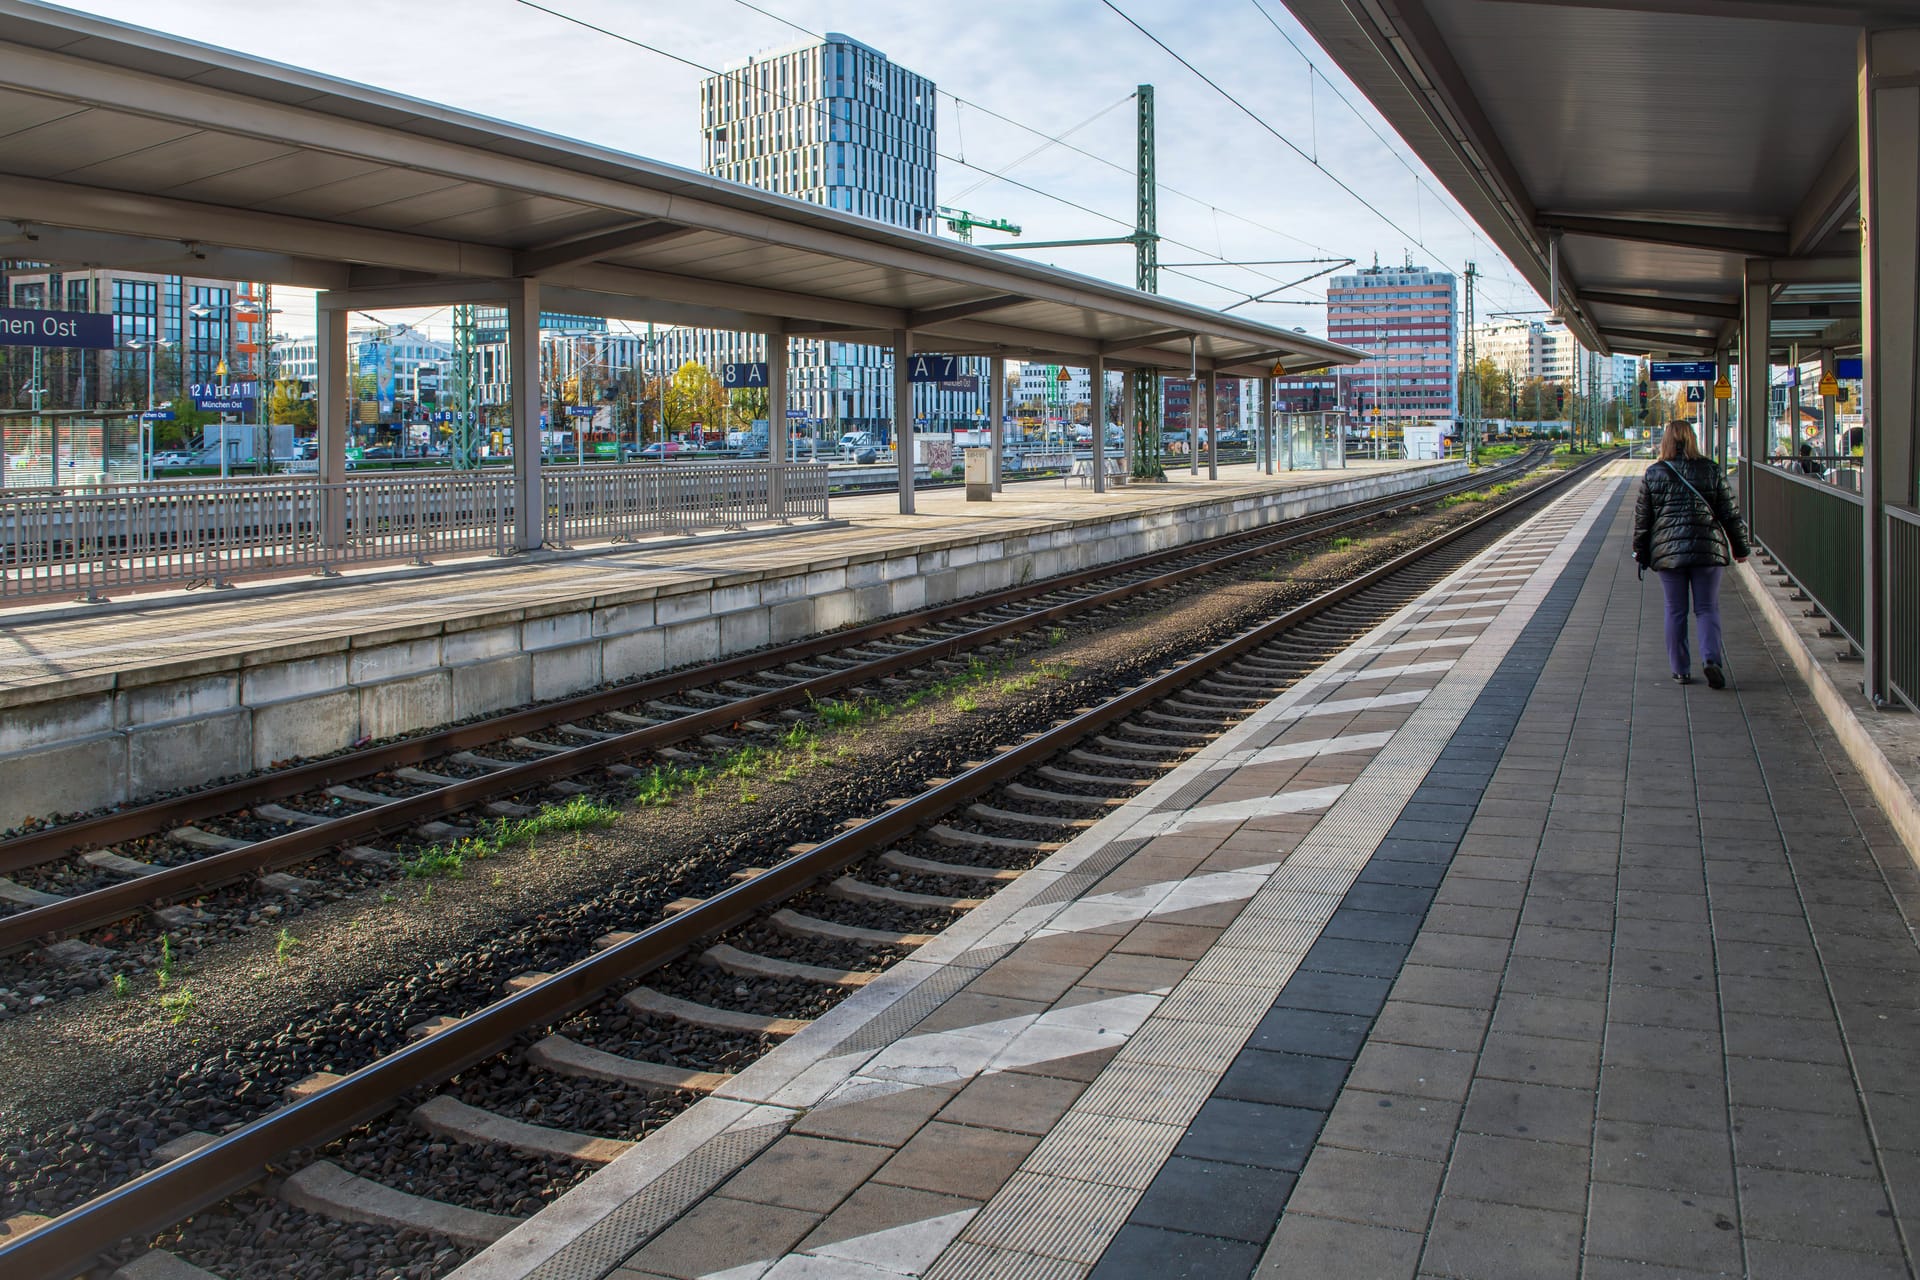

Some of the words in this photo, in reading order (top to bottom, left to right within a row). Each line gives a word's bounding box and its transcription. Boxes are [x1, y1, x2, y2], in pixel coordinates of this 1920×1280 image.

[42, 317, 77, 337] Ost
[914, 357, 929, 377] A
[942, 356, 954, 376] 7
[726, 364, 737, 383] 8
[748, 364, 761, 382] A
[190, 384, 200, 396] 12
[204, 384, 212, 396] A
[232, 383, 240, 395] A
[242, 382, 250, 394] 11
[1690, 388, 1700, 399] A
[446, 412, 450, 420] B
